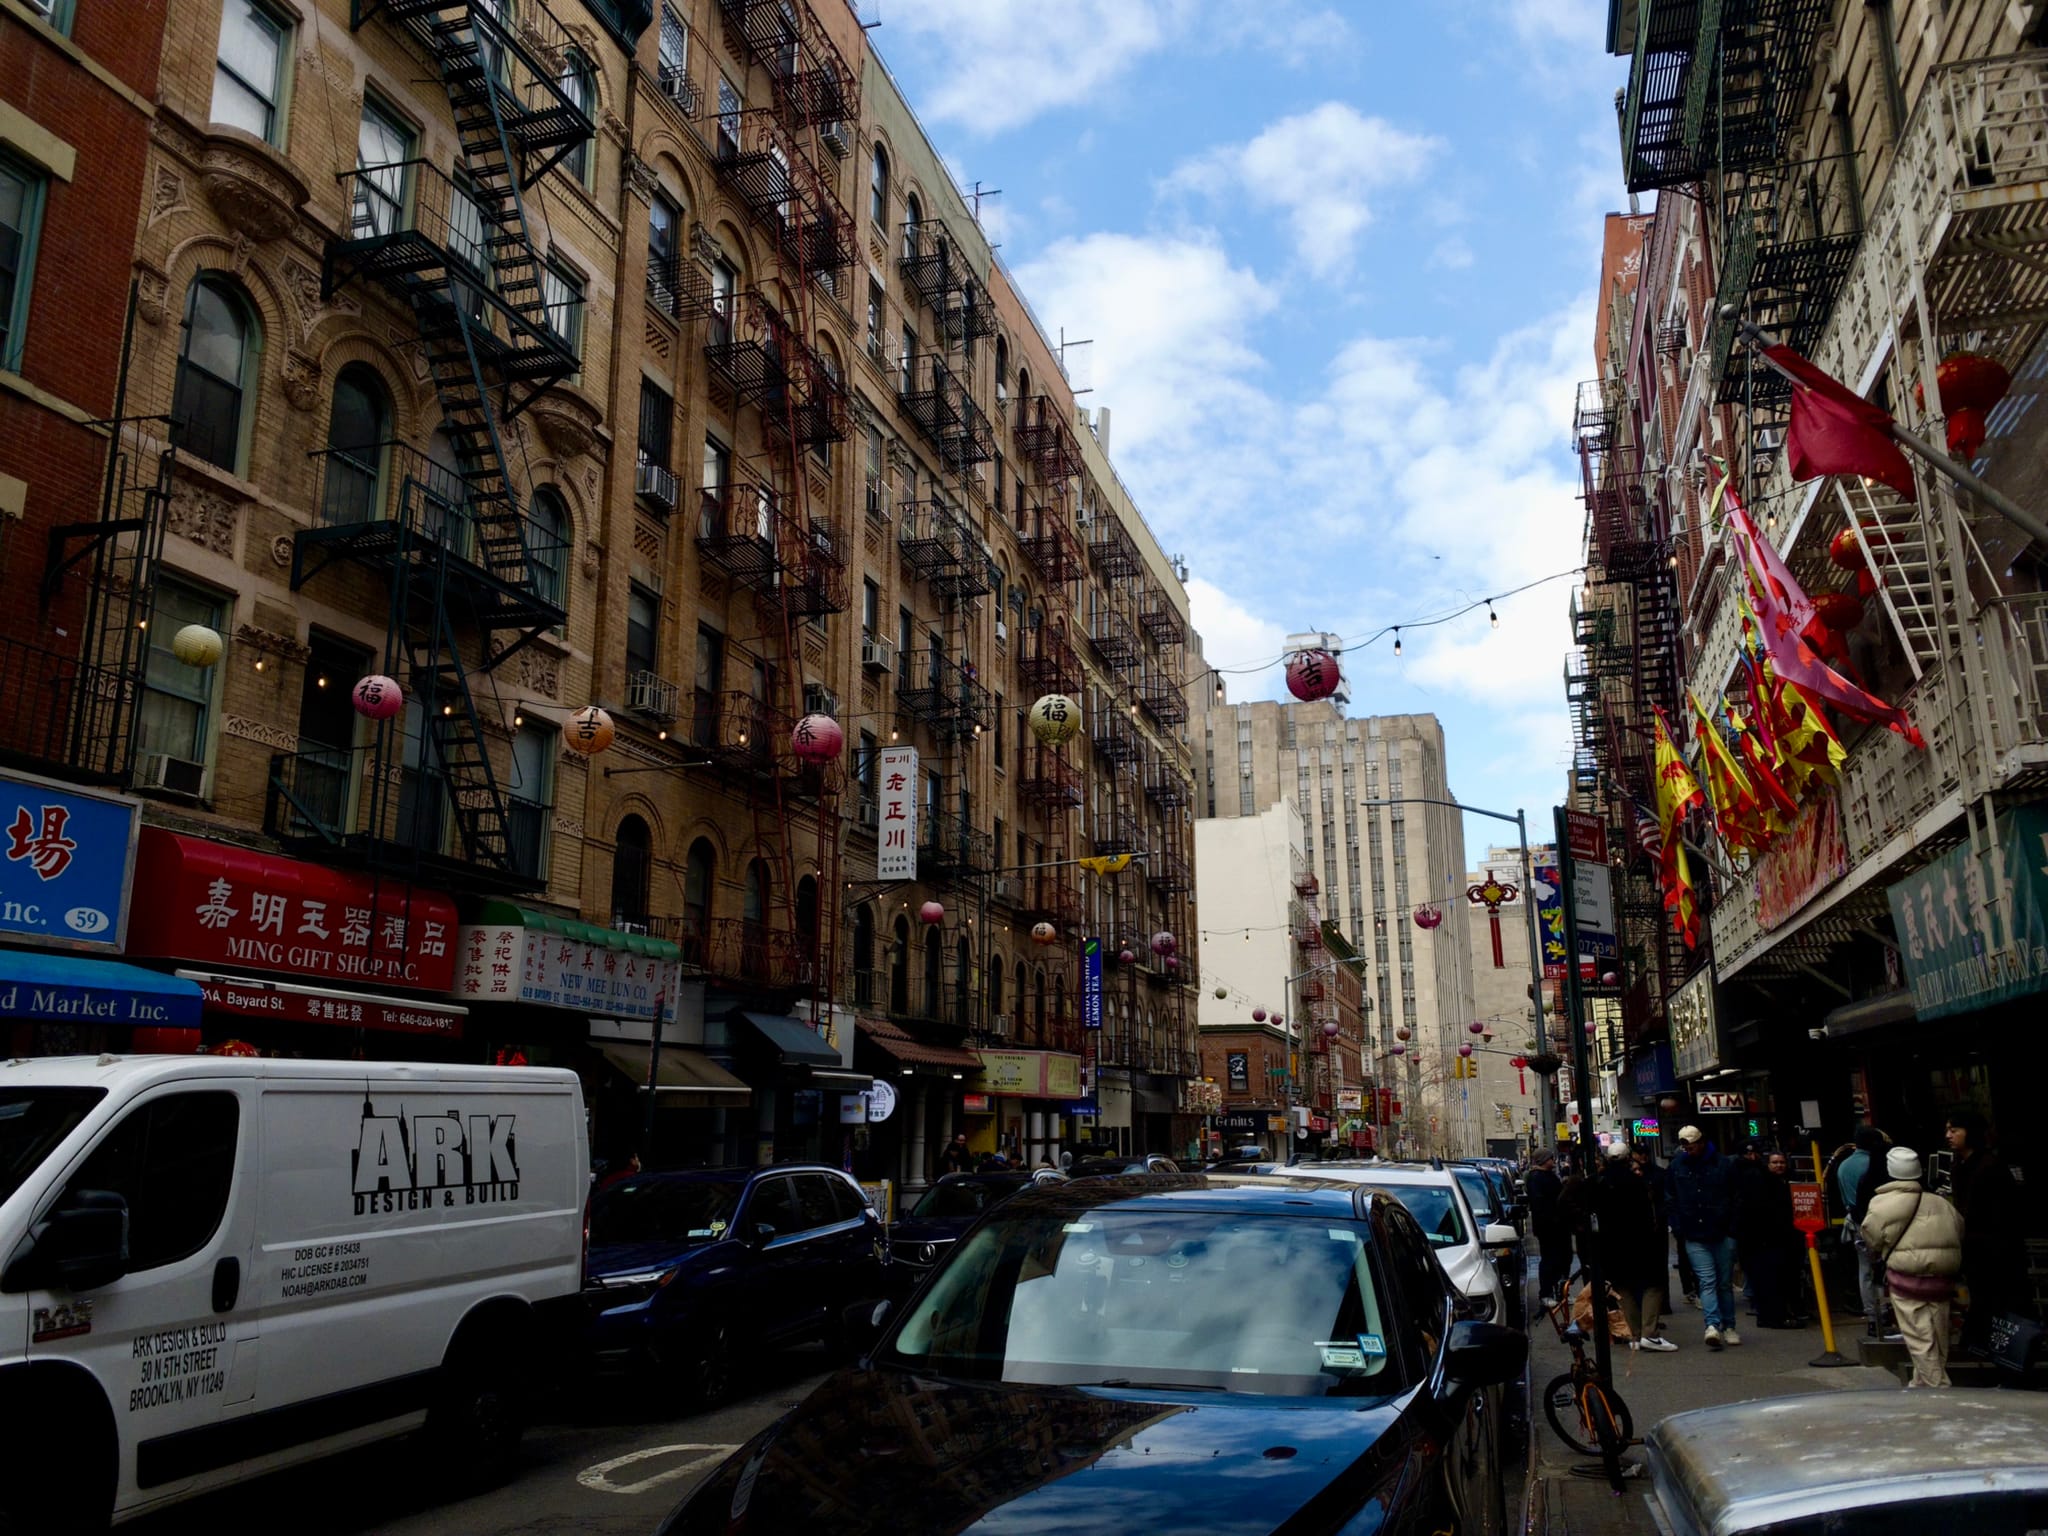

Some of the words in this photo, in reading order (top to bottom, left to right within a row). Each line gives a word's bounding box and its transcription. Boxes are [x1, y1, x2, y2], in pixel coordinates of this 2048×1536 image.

[359, 680, 382, 705] 福
[1042, 698, 1067, 722] 福
[885, 754, 909, 763] 四川
[884, 772, 907, 849] 老正川
[6, 804, 77, 882] 場
[0, 899, 47, 926] nc.
[75, 911, 98, 929] 59
[195, 876, 447, 958] 嘉明玉器禮品
[225, 936, 284, 964] MING
[287, 945, 334, 972] GIFT
[336, 952, 384, 976] SHOP
[386, 960, 420, 982] INC.
[463, 930, 486, 993] 零售批發
[490, 931, 515, 993] 祭祀供品
[560, 972, 583, 990] NEW
[587, 977, 607, 994] MEE
[611, 981, 631, 997] LUN
[633, 985, 648, 1001] CO.
[1091, 975, 1100, 992] TEA
[29, 989, 118, 1017] Market
[128, 997, 169, 1021] Inc.
[226, 991, 268, 1009] Bayard
[270, 997, 286, 1011] St.
[307, 999, 363, 1022] 零售批發
[1091, 994, 1100, 1026] LEMON
[381, 1009, 398, 1023] Tel:
[1701, 1093, 1744, 1107] ATM
[1215, 1115, 1256, 1127] Gnius
[352, 1113, 520, 1195] ARK
[354, 1188, 432, 1216] DESIGN
[443, 1190, 454, 1207] &
[465, 1183, 519, 1204] BUILD
[295, 1247, 313, 1261] DOB
[315, 1246, 327, 1259] GC
[328, 1245, 334, 1256] #
[335, 1242, 361, 1256] 615438
[281, 1267, 296, 1280] HIC
[298, 1262, 333, 1278] LICENSE
[333, 1261, 339, 1272] #
[340, 1257, 369, 1272] 2034751
[281, 1273, 367, 1298] NOAH@ARKDAB.COM
[132, 1334, 154, 1359] ARK
[154, 1327, 190, 1354] DESIGN
[191, 1326, 199, 1347] &
[200, 1321, 226, 1346] BUILD
[141, 1360, 153, 1383] 50
[154, 1358, 162, 1380] N
[163, 1354, 181, 1378] 5TH
[182, 1346, 218, 1375] STREET
[129, 1380, 184, 1412] BROOKLYN,
[186, 1375, 199, 1399] NY
[201, 1370, 225, 1395] 11249
